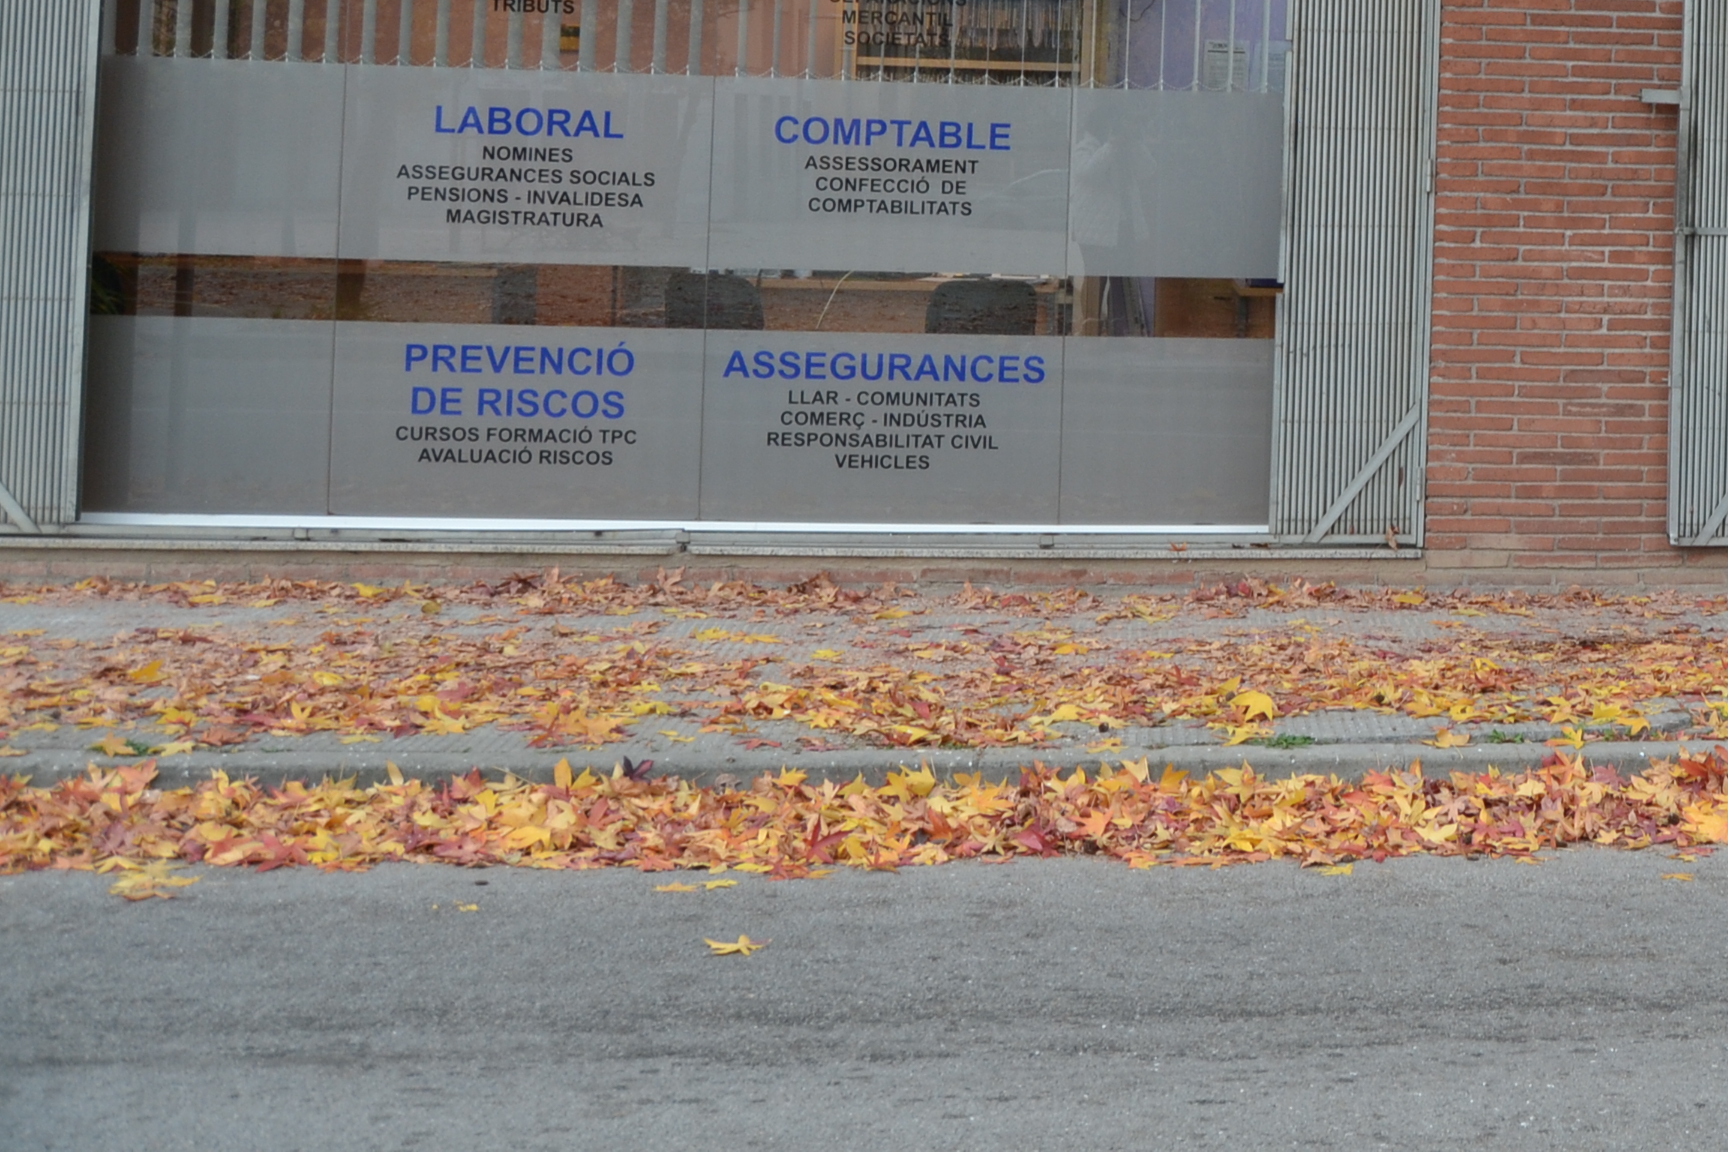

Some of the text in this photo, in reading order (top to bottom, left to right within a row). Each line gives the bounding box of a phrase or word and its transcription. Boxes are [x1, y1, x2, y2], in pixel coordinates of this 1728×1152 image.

[842, 10, 953, 27] MERCANTIL
[844, 30, 951, 47] SOCIETATS
[434, 105, 624, 139] LABORAL
[775, 115, 1012, 151] COMPTABLE
[482, 145, 573, 163] NOMINES
[804, 155, 979, 174] ASSESSORAMENT
[396, 164, 656, 187] ASSEGURANCES SOCIALS
[815, 175, 967, 196] CONFECCIÓ DE
[407, 186, 509, 204] PENSIONS
[527, 189, 644, 208] INVALIDESA
[808, 197, 972, 216] COMPTABILITATS
[446, 209, 604, 228] MAGISTRATURA
[405, 341, 635, 377] PREVENCIÓ
[723, 350, 1046, 384] ASSEGURANCES
[411, 386, 625, 419] DE RISCOS
[788, 390, 838, 405] LLAR
[856, 391, 981, 408] COMUNITATS
[780, 411, 864, 430] COMERÇ
[883, 410, 986, 429] INDÚSTRIA
[395, 425, 637, 445] CURSOS FORMACIÓ TPC
[767, 432, 999, 450] RESPONSABILITAT CIVIL
[418, 446, 613, 466] AVALUACIÓ RISCOS
[835, 454, 930, 470] VEHICLES
